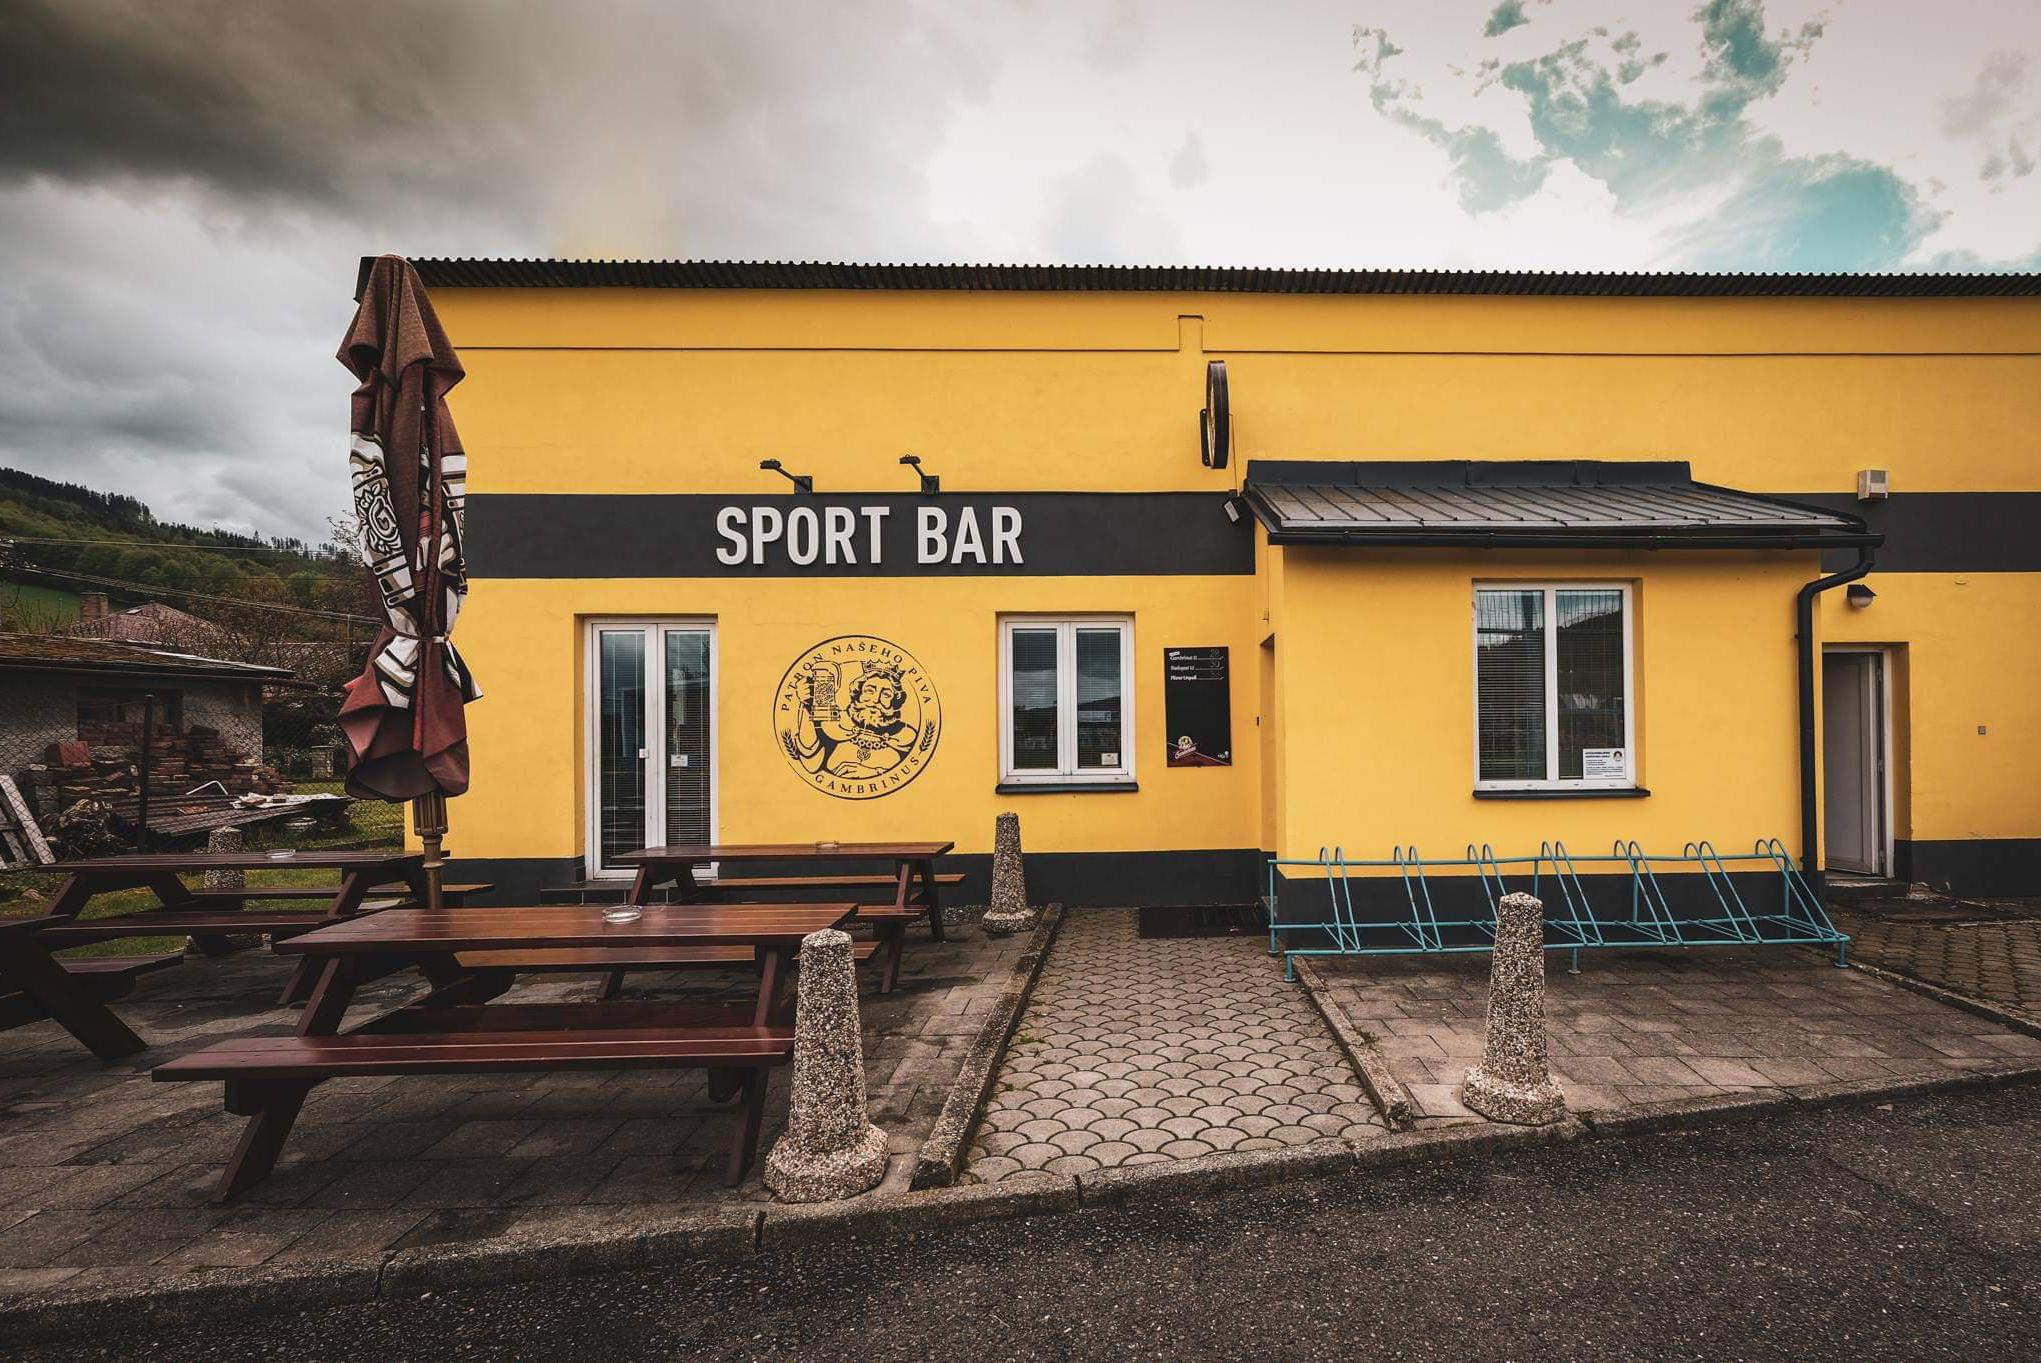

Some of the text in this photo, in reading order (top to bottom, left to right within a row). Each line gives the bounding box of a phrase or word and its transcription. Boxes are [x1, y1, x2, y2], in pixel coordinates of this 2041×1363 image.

[715, 505, 1024, 566] SPORT BAR
[781, 641, 932, 711] PATRON NAŠEHO PIVA
[815, 756, 919, 794] GAMBRINUS
